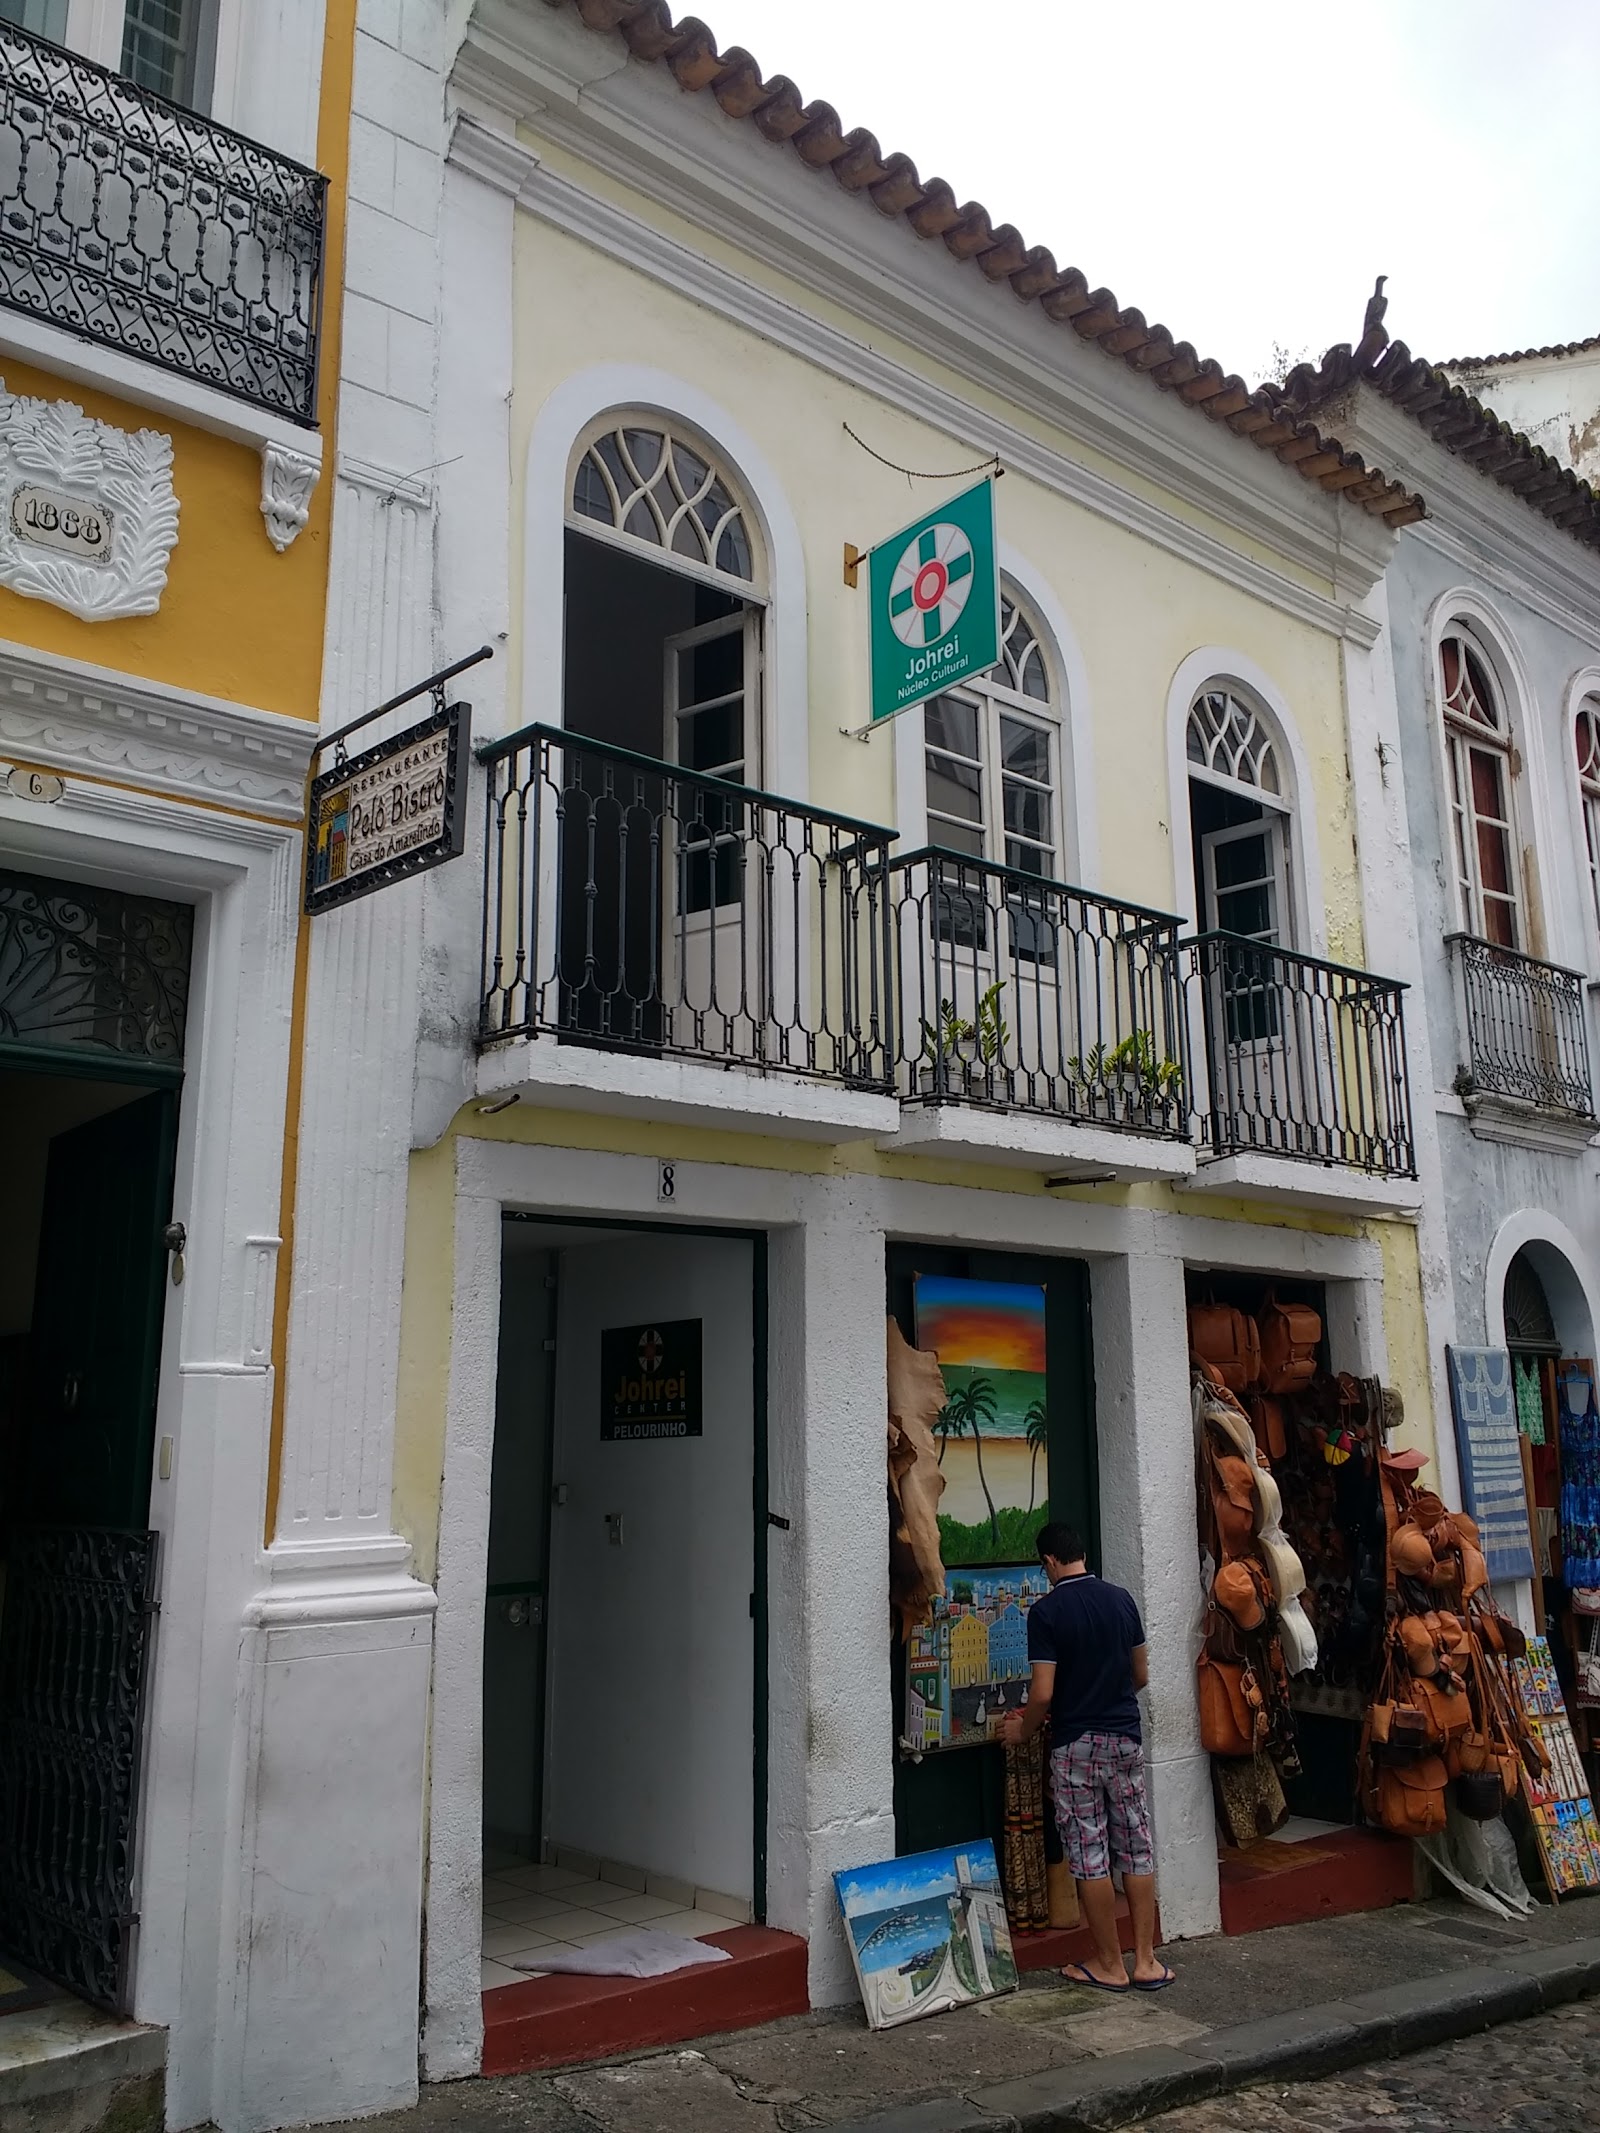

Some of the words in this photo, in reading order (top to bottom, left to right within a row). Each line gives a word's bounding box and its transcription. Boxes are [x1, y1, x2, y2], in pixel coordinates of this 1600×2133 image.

[25, 498, 101, 545] 1868
[905, 634, 959, 680] Johrei
[898, 677, 929, 700] Núcleo
[931, 654, 969, 683] Cultural
[353, 737, 449, 795] RESTAURANTE
[350, 795, 385, 846] Pelô
[392, 766, 445, 828] Bistrô
[349, 850, 374, 871] Casa
[374, 842, 385, 861] do
[662, 1166, 674, 1197] 8
[614, 1370, 686, 1403] Johrei
[614, 1401, 686, 1415] CENTER
[613, 1422, 687, 1438] PELOURINHO
